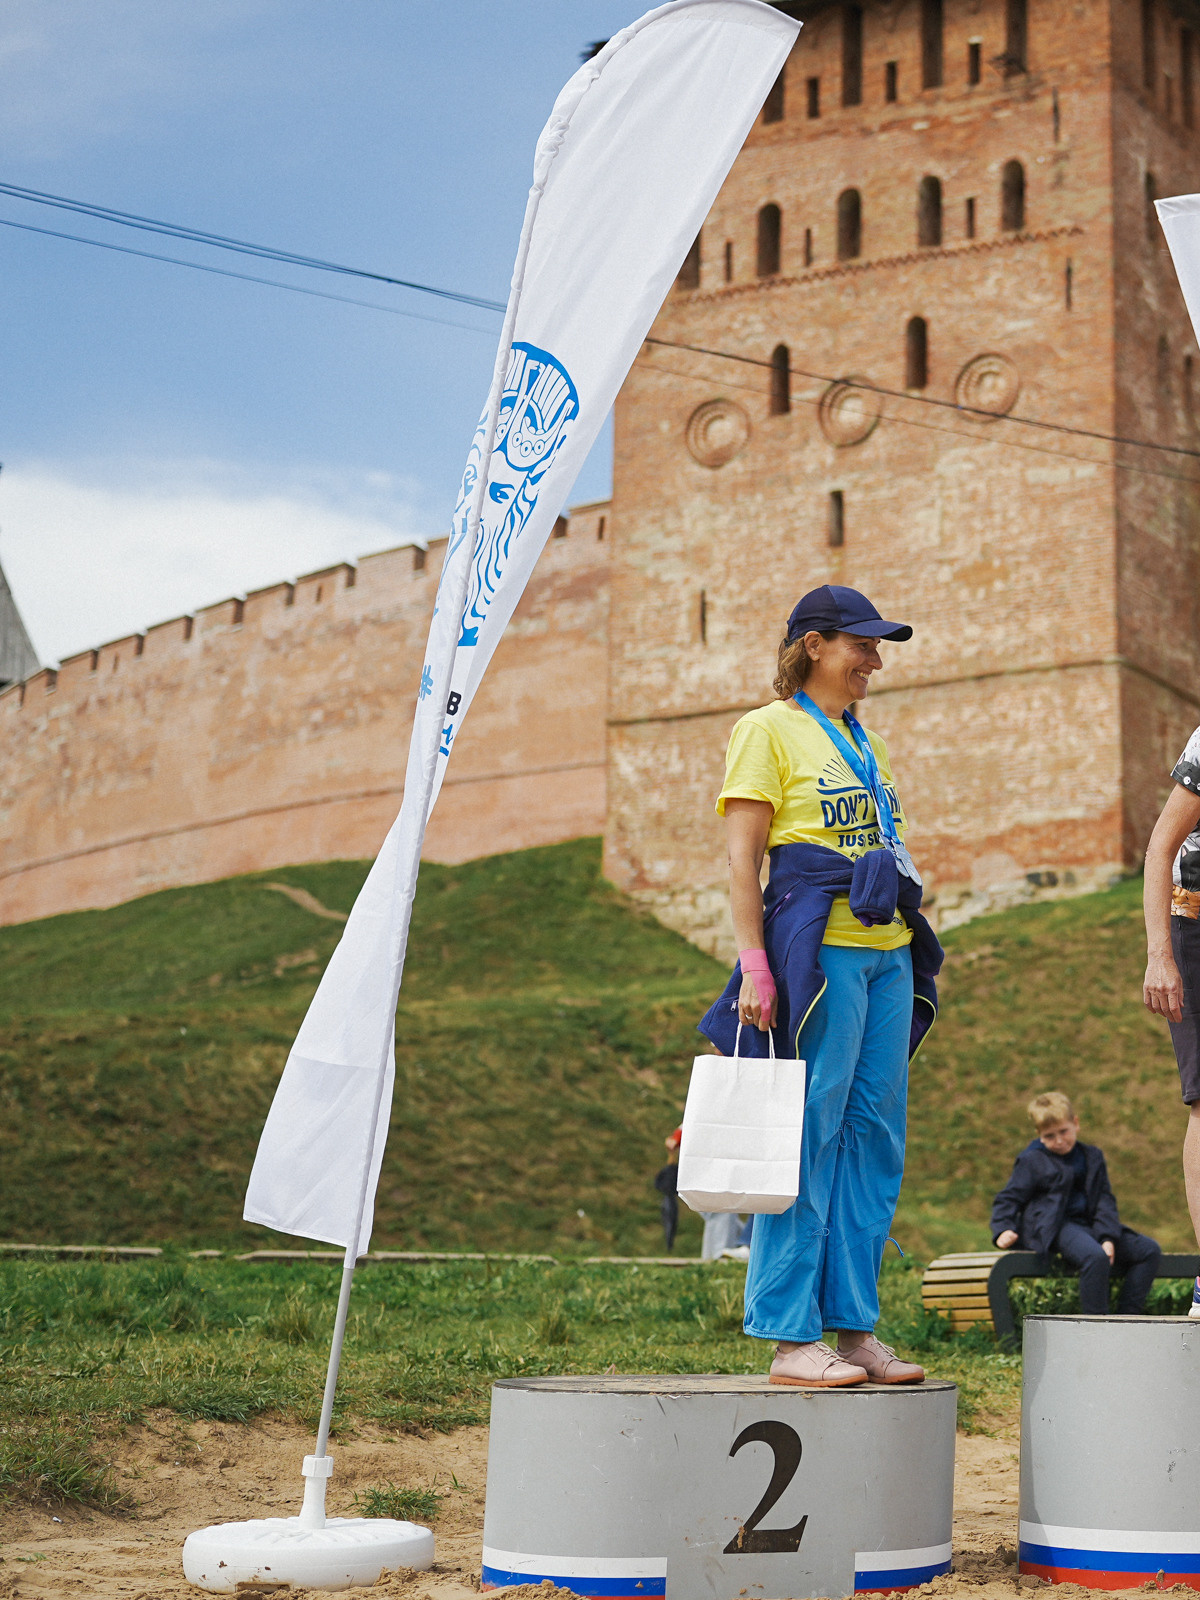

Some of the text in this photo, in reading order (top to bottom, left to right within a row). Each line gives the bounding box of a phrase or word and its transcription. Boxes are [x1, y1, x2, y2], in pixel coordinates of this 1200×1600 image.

[820, 793, 869, 828] DON'T
[837, 833, 867, 848] JUS
[723, 1420, 809, 1555] 2
